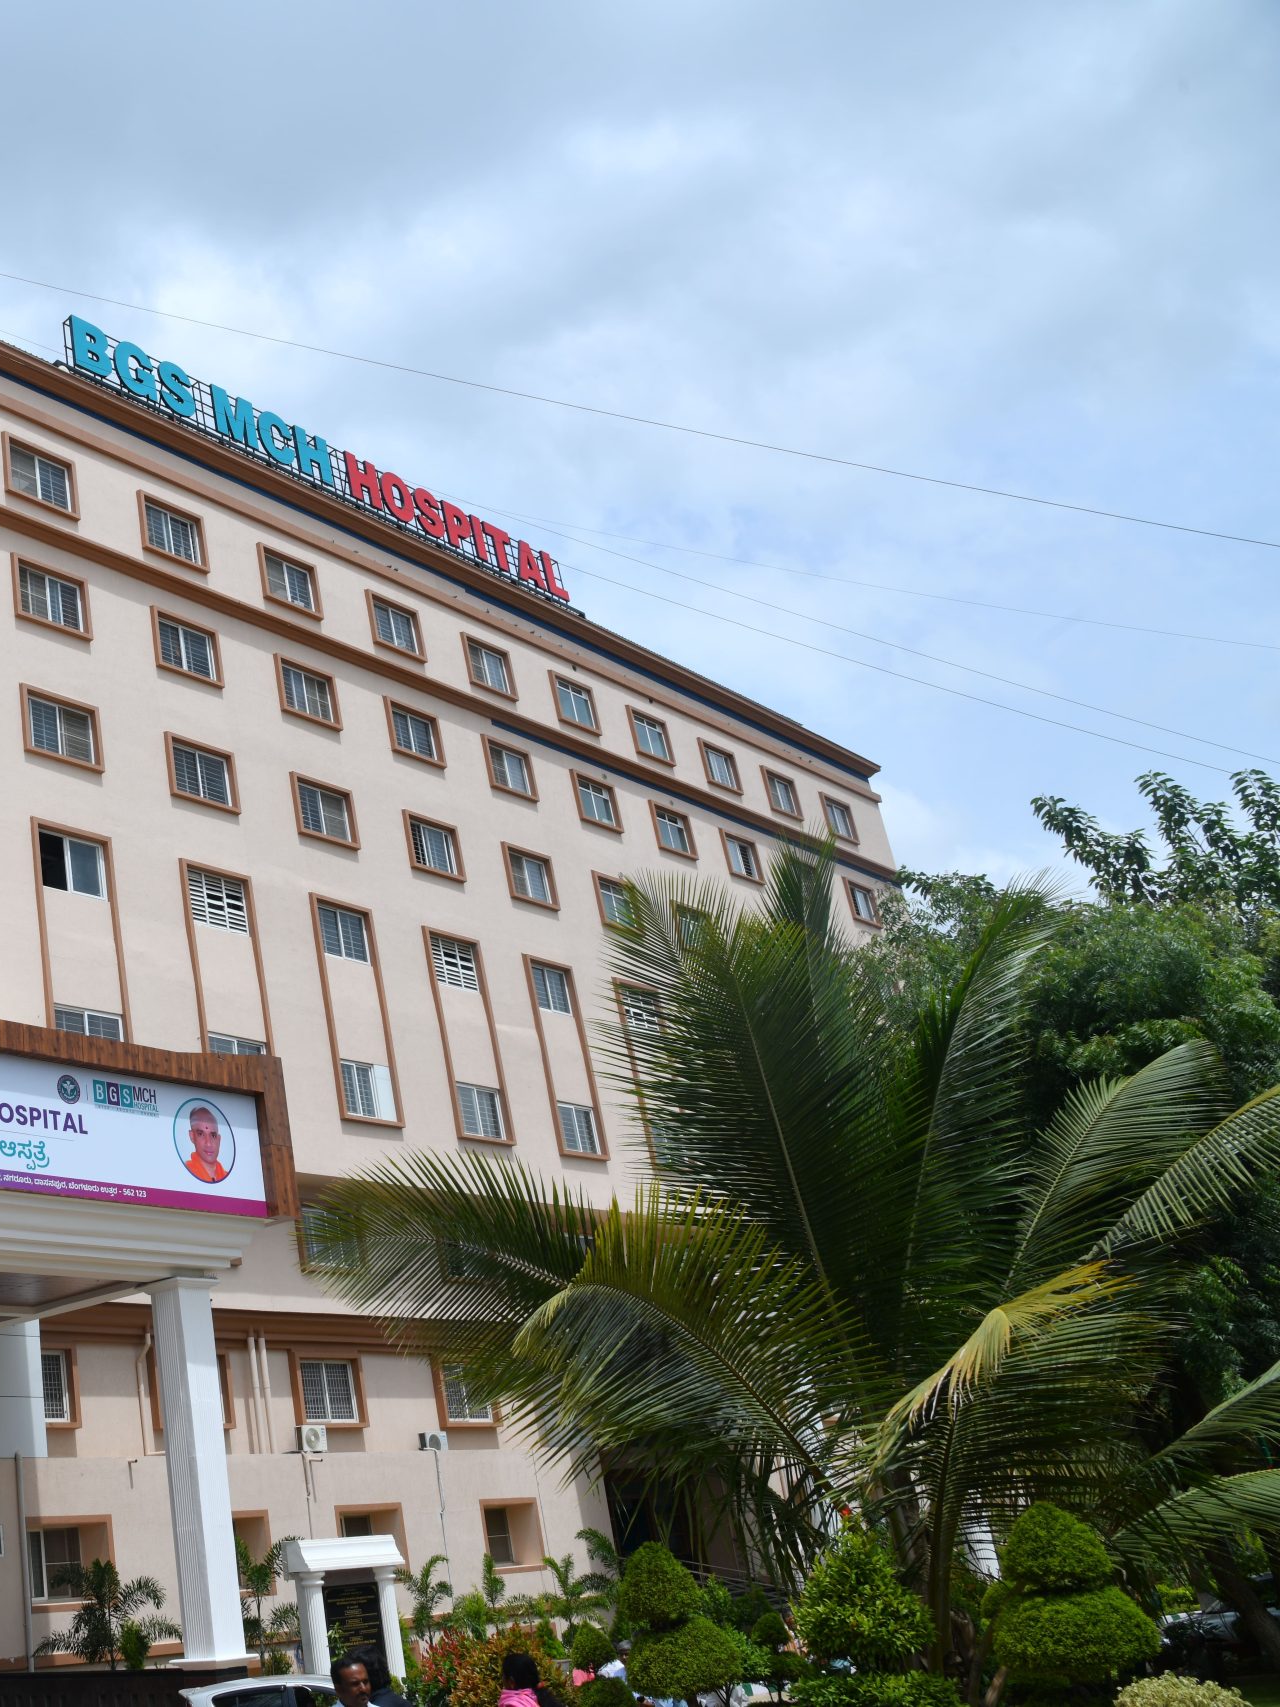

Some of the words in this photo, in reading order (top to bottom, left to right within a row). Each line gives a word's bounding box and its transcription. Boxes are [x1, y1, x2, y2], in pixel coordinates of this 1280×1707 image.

[69, 314, 197, 419] BGS
[209, 383, 335, 488] MCH
[343, 450, 571, 603] HOSPITAL
[133, 1101, 160, 1113] HOSPITAL
[0, 1139, 51, 1171] ಆಸ್ಪತ್ರೆ
[122, 1188, 135, 1197] 562
[135, 1189, 147, 1198] 123
